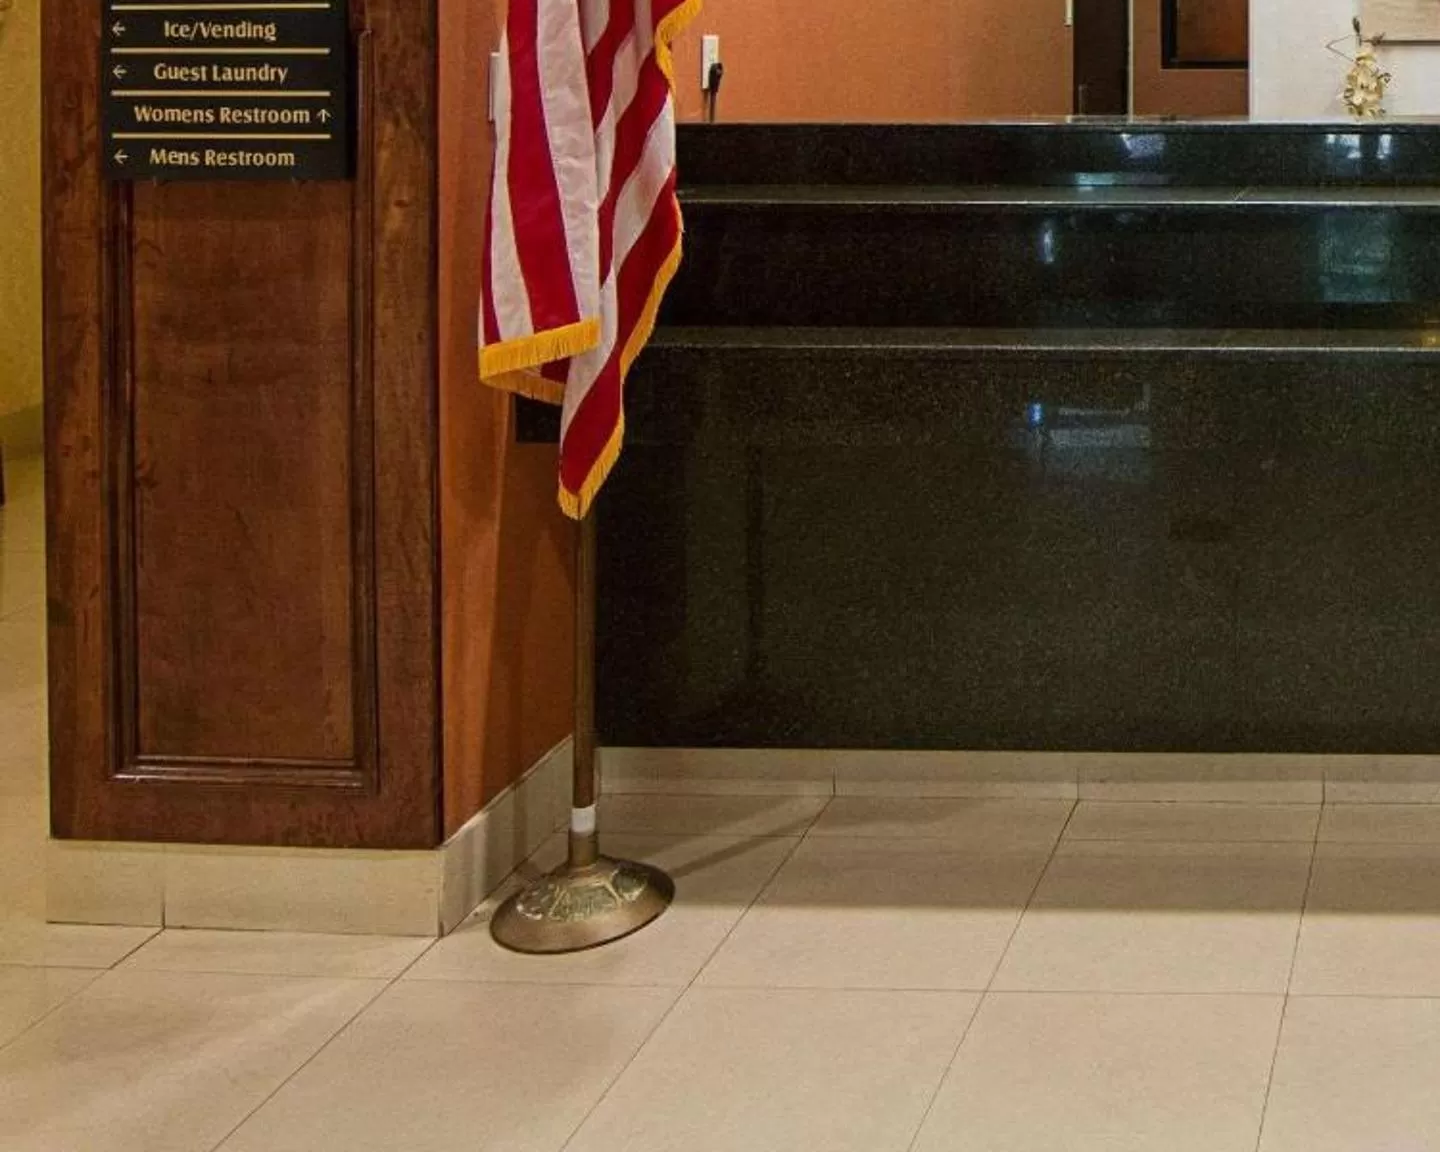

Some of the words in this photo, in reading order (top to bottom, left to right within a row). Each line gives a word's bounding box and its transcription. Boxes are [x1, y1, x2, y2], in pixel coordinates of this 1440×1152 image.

[164, 21, 277, 41] Ice/Vending
[153, 63, 207, 81] Guest
[212, 63, 288, 84] Laundry
[134, 106, 215, 124] Womens
[219, 107, 310, 124] Restroom
[149, 148, 200, 166] Mens
[204, 149, 295, 166] Restroom
